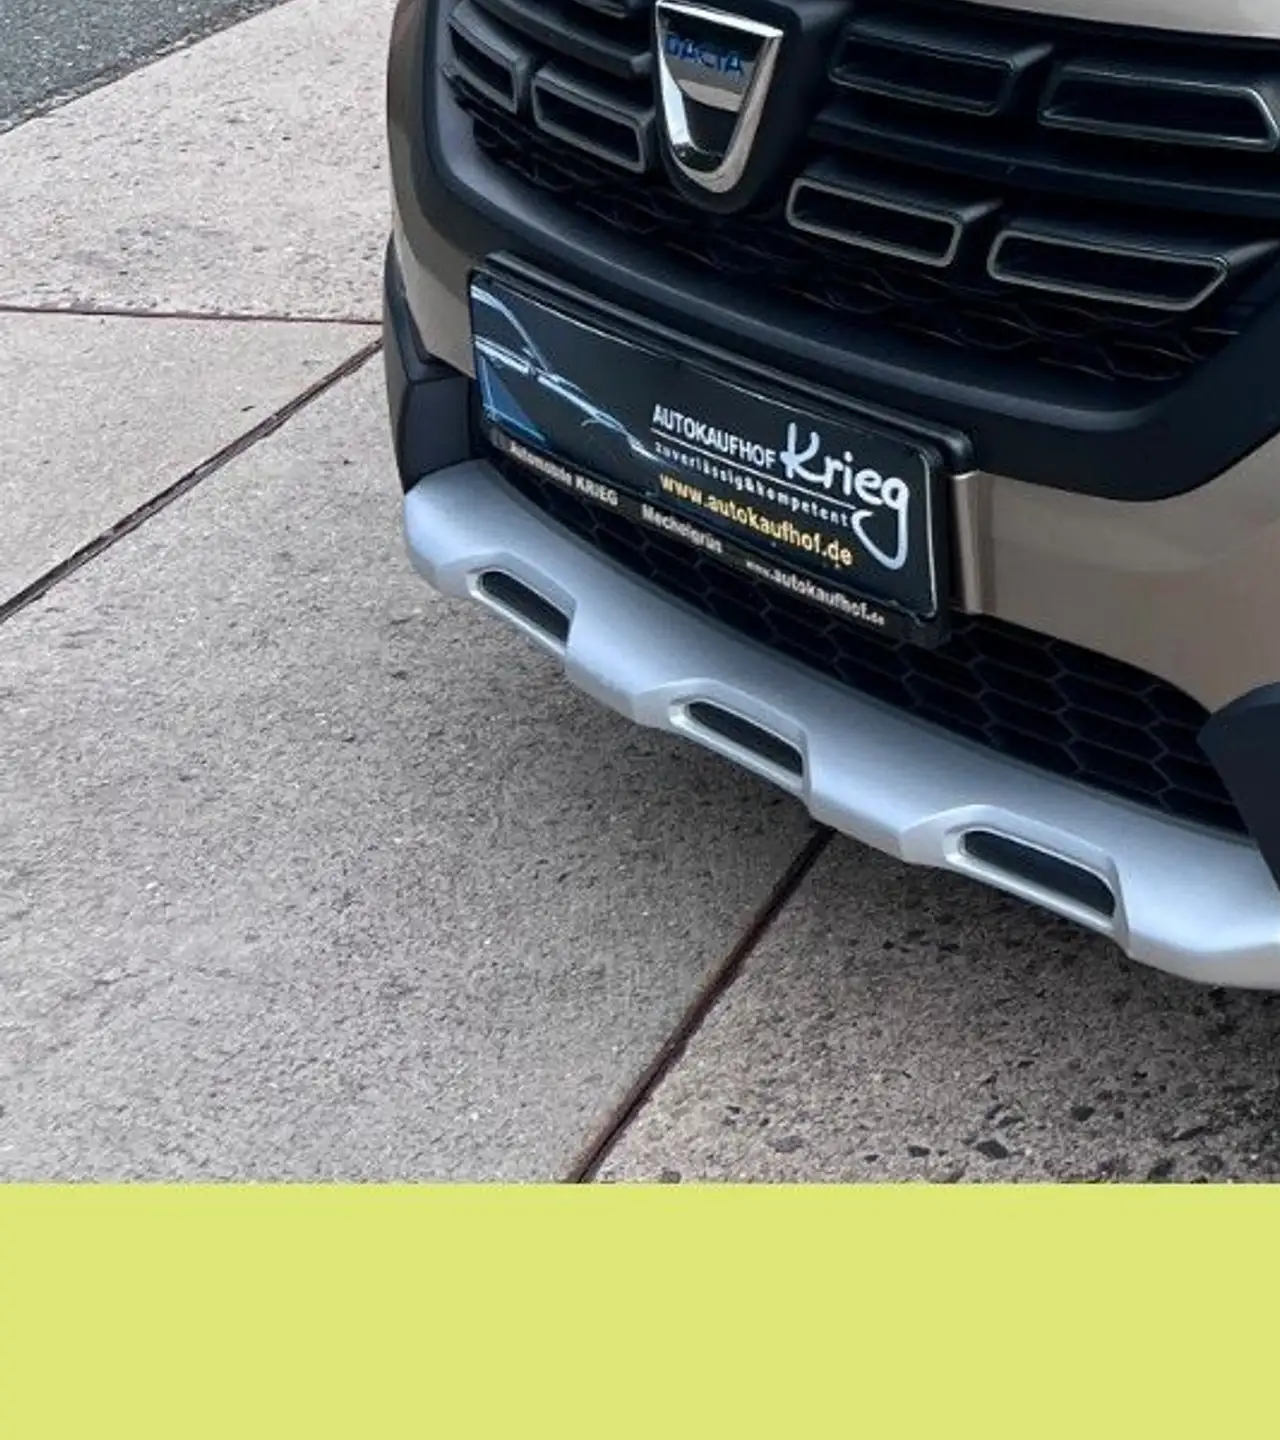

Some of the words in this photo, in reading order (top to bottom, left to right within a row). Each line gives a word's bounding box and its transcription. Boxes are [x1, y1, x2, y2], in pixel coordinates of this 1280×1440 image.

[664, 33, 745, 77] DACIA
[575, 474, 619, 507] KRIEG
[652, 403, 777, 470] AUTOKAUFHOF
[779, 421, 910, 571] Krieg
[659, 472, 854, 568] www.autokaufhof.de
